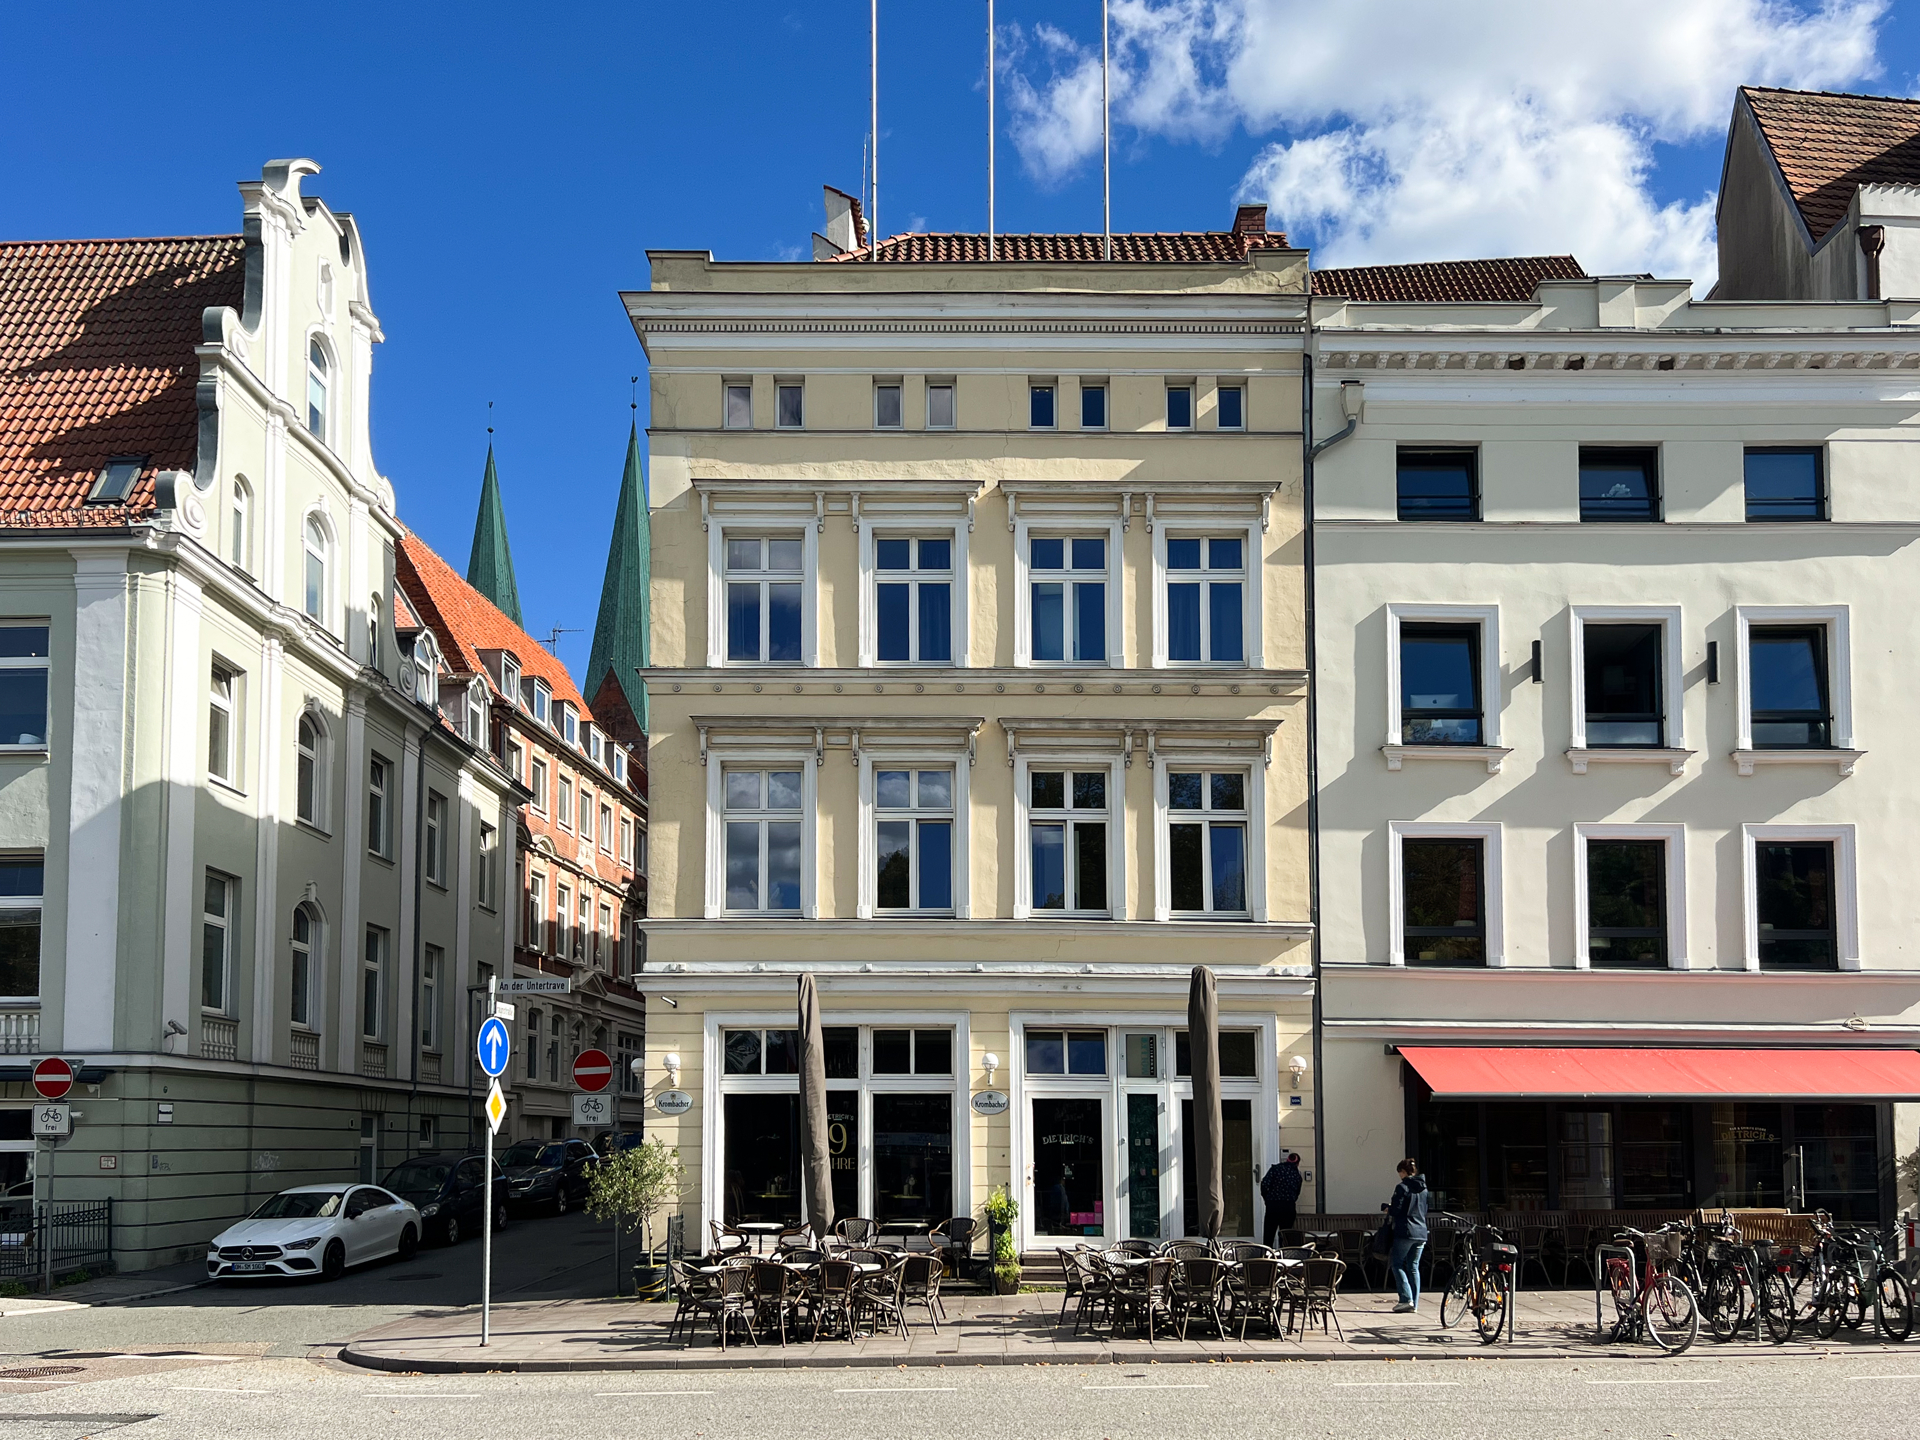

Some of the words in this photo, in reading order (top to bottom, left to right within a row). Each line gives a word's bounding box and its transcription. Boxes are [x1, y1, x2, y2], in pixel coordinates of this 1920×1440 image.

[499, 981, 508, 990] An
[511, 981, 523, 990] der
[526, 981, 565, 990] Untertrave
[658, 1099, 690, 1108] Krombacher
[974, 1100, 1006, 1108] Krombacher
[585, 1114, 599, 1122] frei
[45, 1123, 57, 1131] frei
[831, 1157, 855, 1170] HRE
